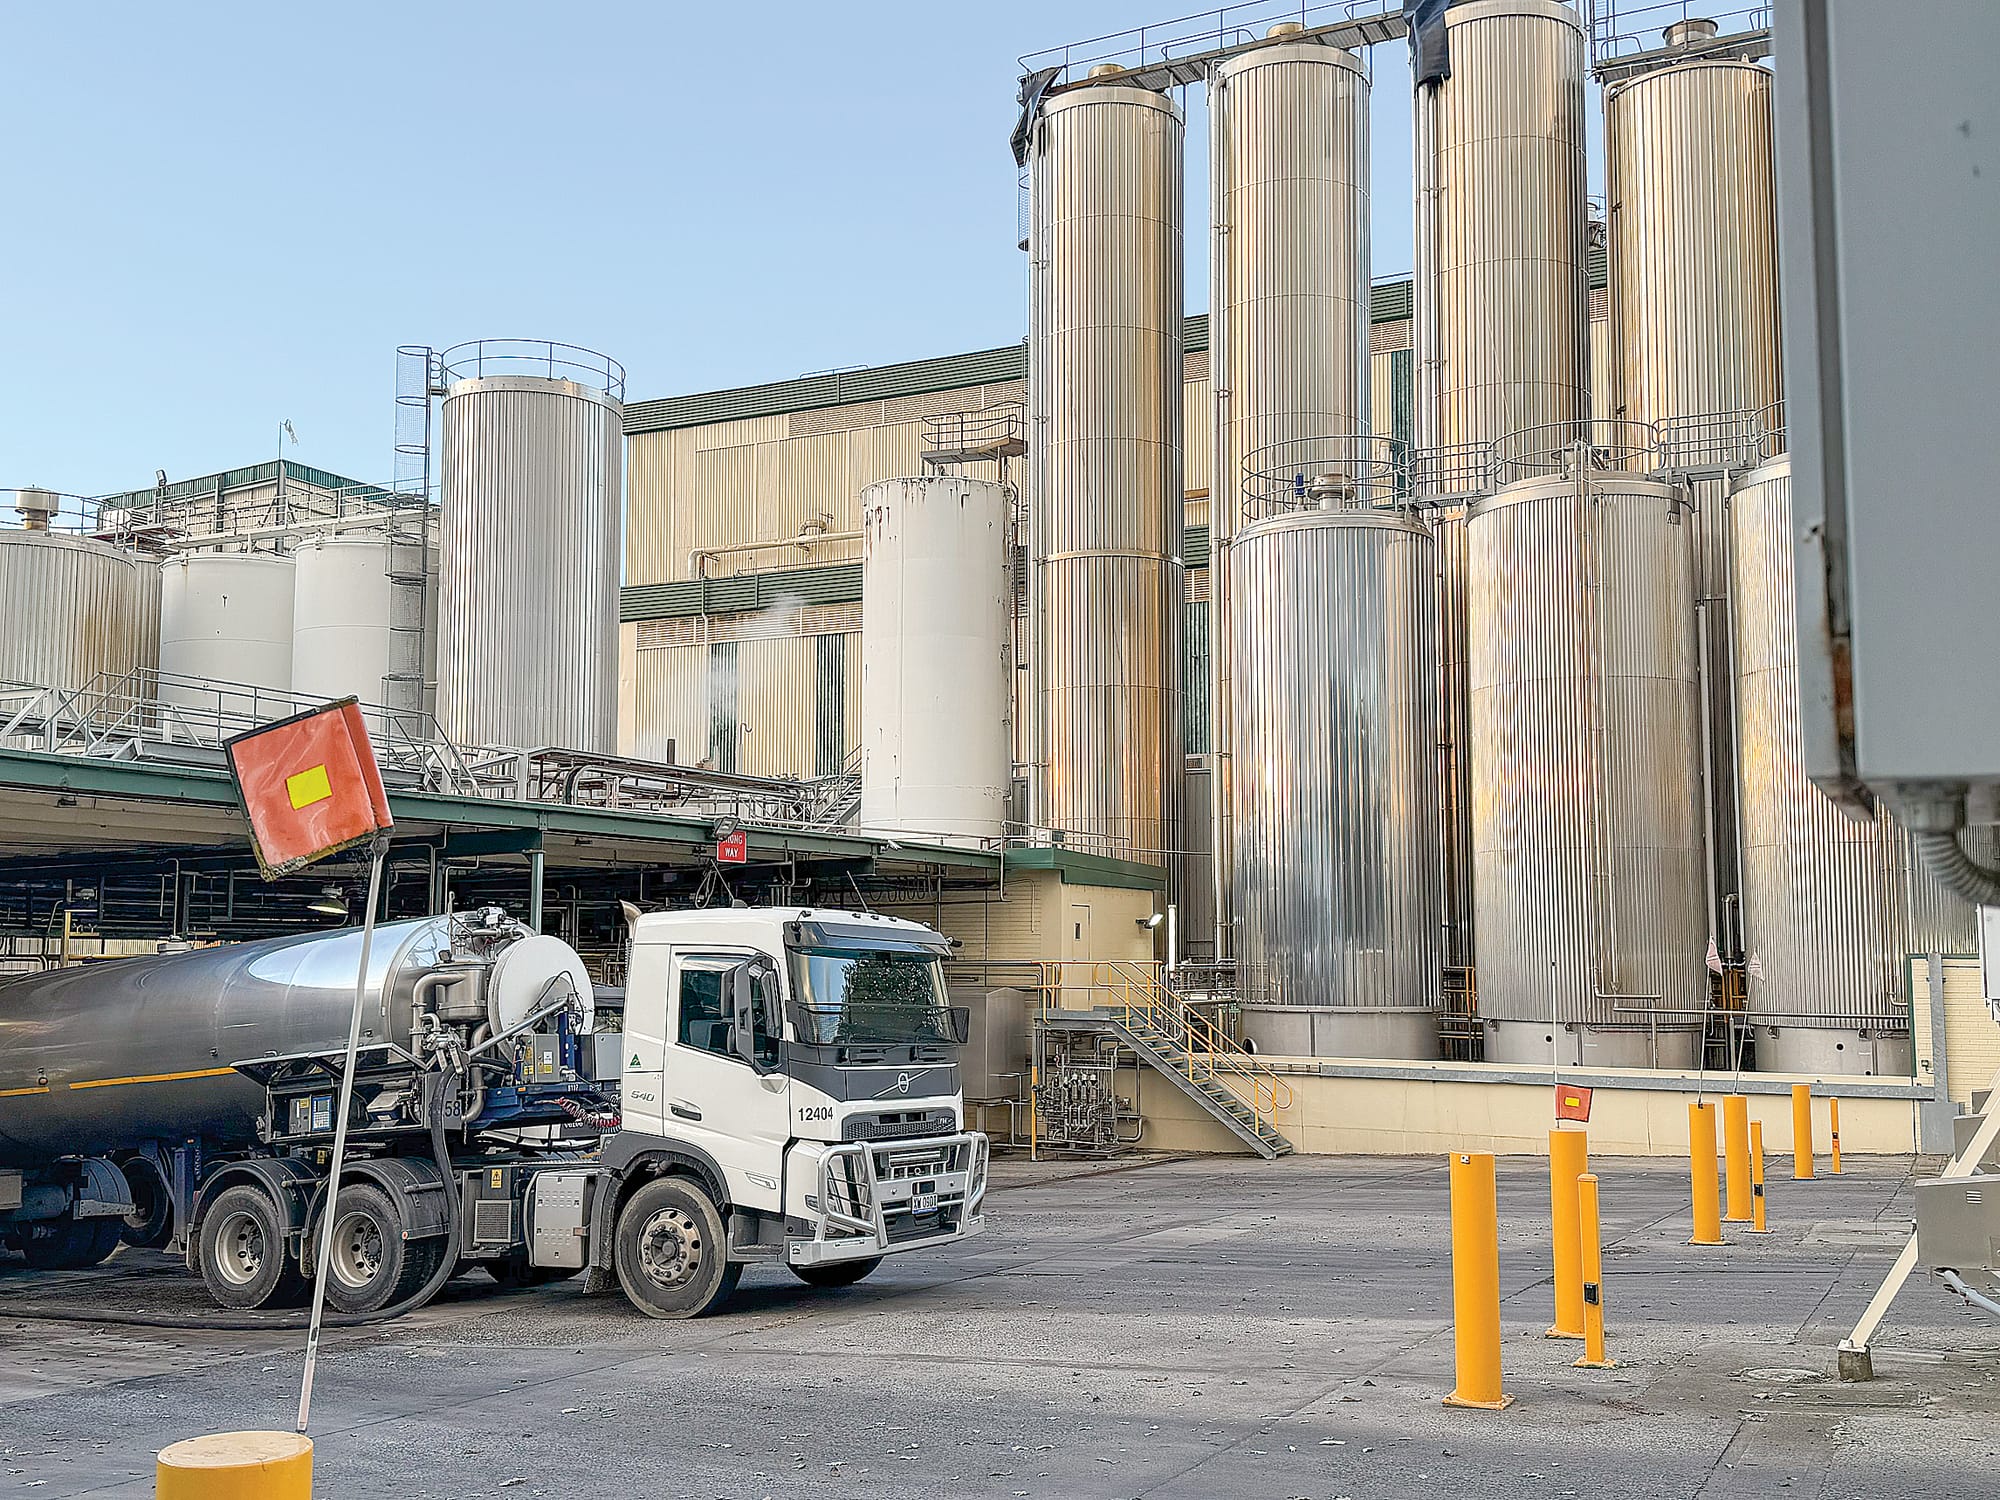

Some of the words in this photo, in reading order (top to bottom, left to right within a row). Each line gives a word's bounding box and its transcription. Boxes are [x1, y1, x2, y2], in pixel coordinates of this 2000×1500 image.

[724, 847, 739, 858] WAY
[631, 1090, 655, 1102] 540
[798, 1106, 834, 1121] 12404
